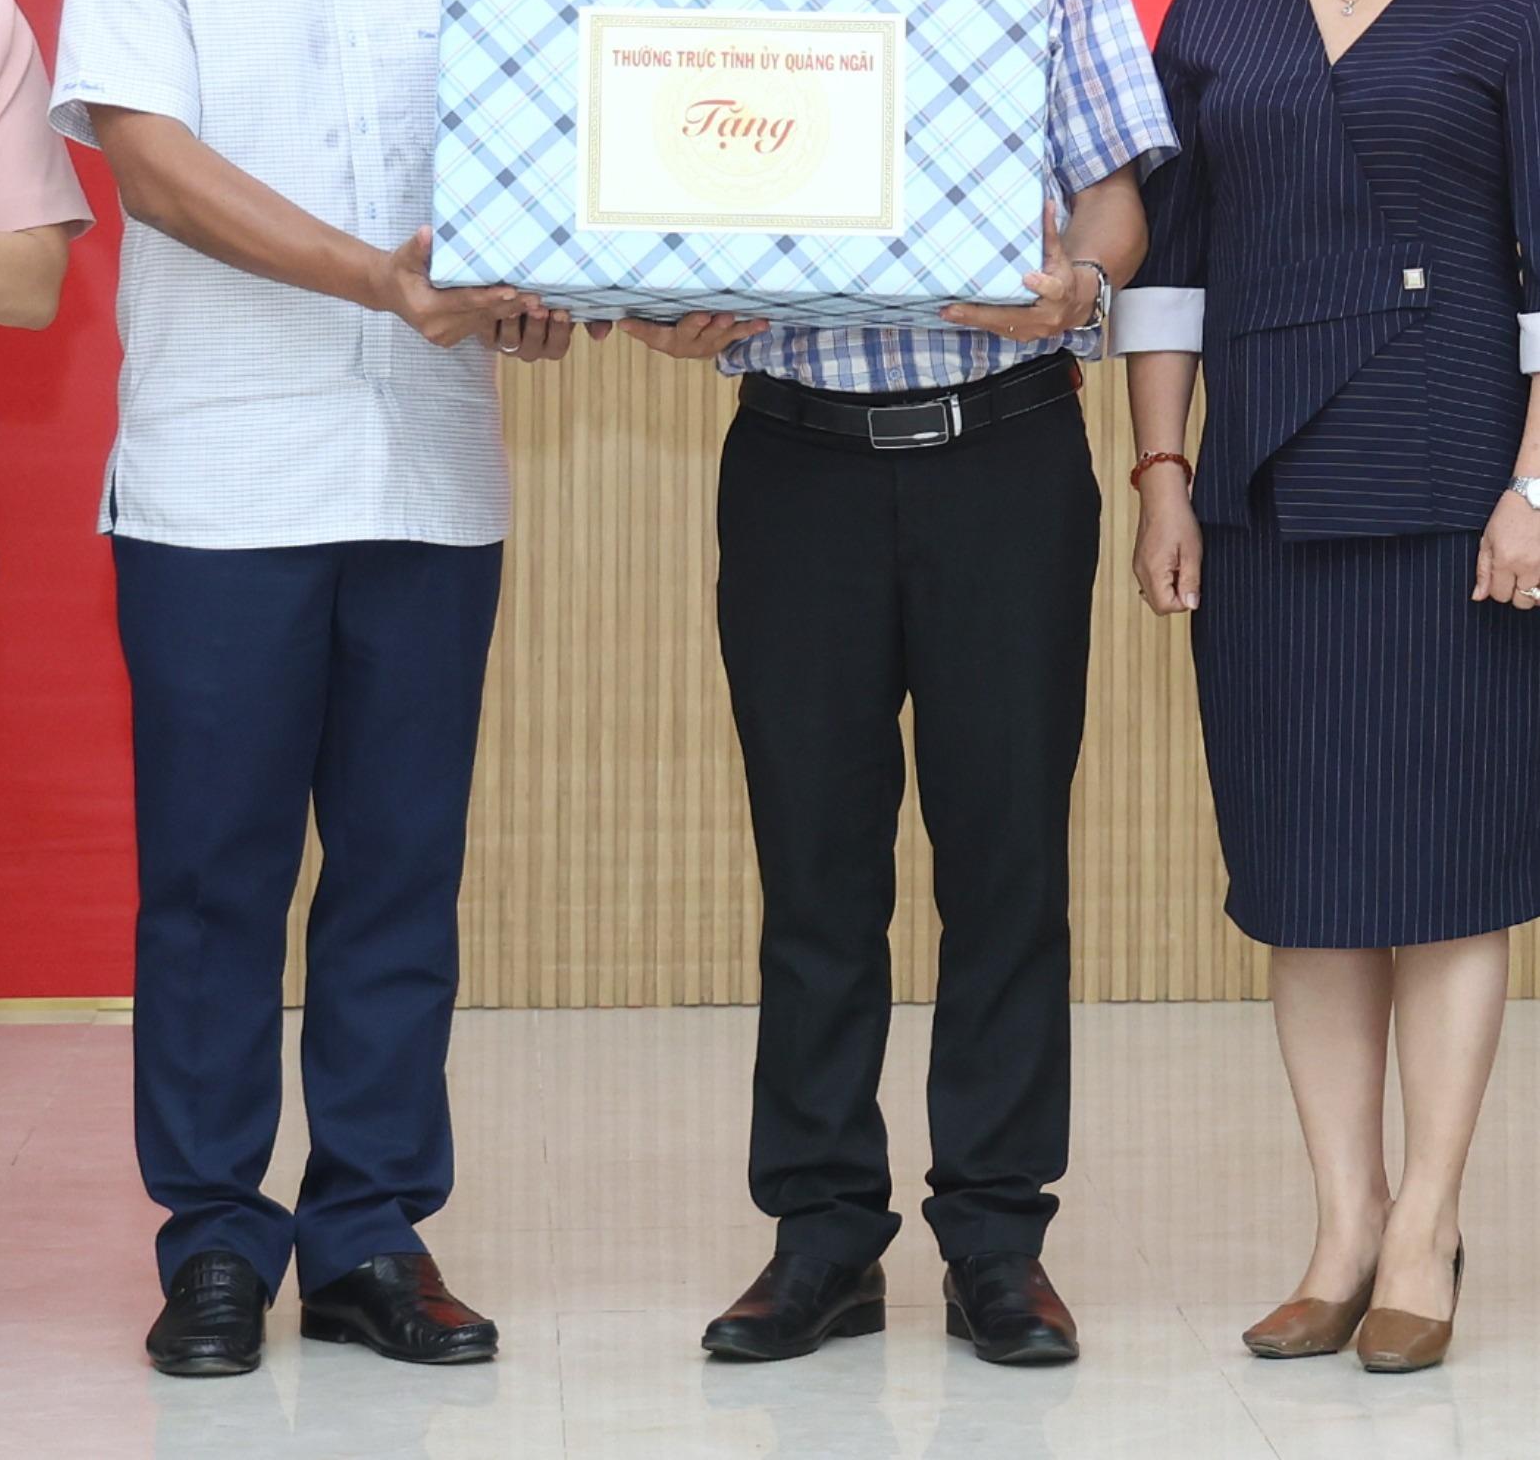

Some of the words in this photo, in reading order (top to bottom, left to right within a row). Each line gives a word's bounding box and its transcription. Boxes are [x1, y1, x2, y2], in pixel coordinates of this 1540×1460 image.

[612, 44, 673, 68] THƯỜNG
[676, 47, 717, 72] TRỰC
[721, 45, 755, 69] TỈNH
[760, 45, 780, 70] ỦY
[785, 47, 835, 73] QUẢNG
[839, 49, 874, 71] NGÃI
[681, 98, 796, 155] Tặng
